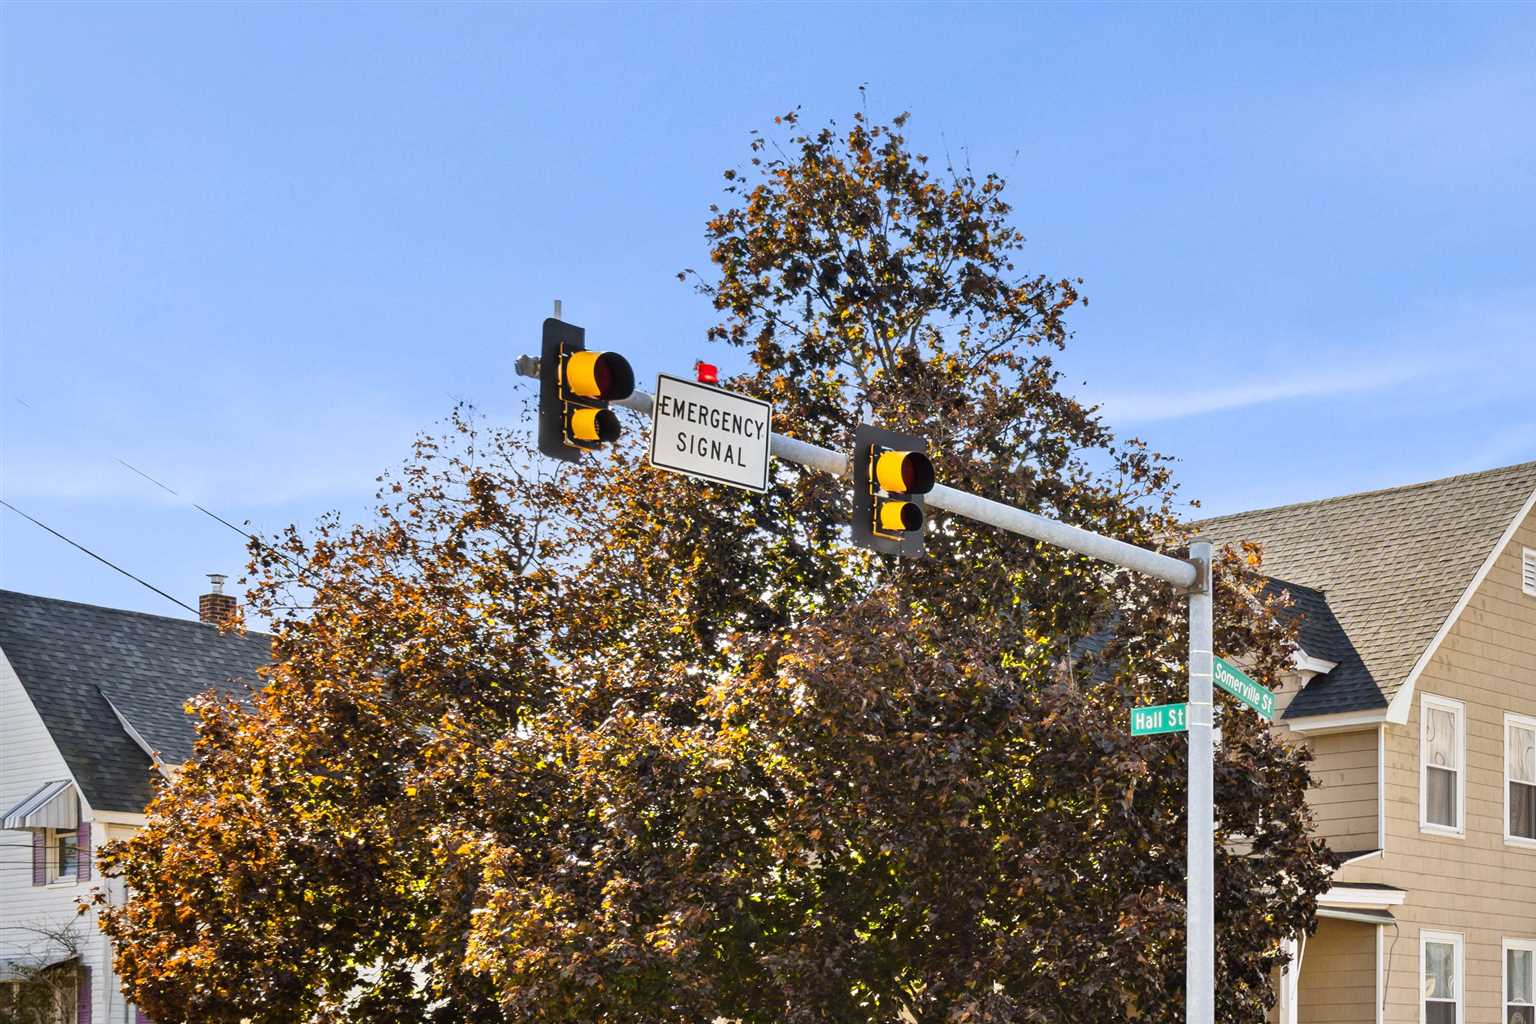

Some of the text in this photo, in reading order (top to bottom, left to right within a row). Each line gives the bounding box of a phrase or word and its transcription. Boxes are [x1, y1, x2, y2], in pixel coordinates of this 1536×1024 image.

[661, 395, 764, 440] EMERGENCY
[676, 432, 746, 468] SIGNAL
[1215, 663, 1272, 713] Somerville St
[1135, 709, 1184, 730] Hall St
